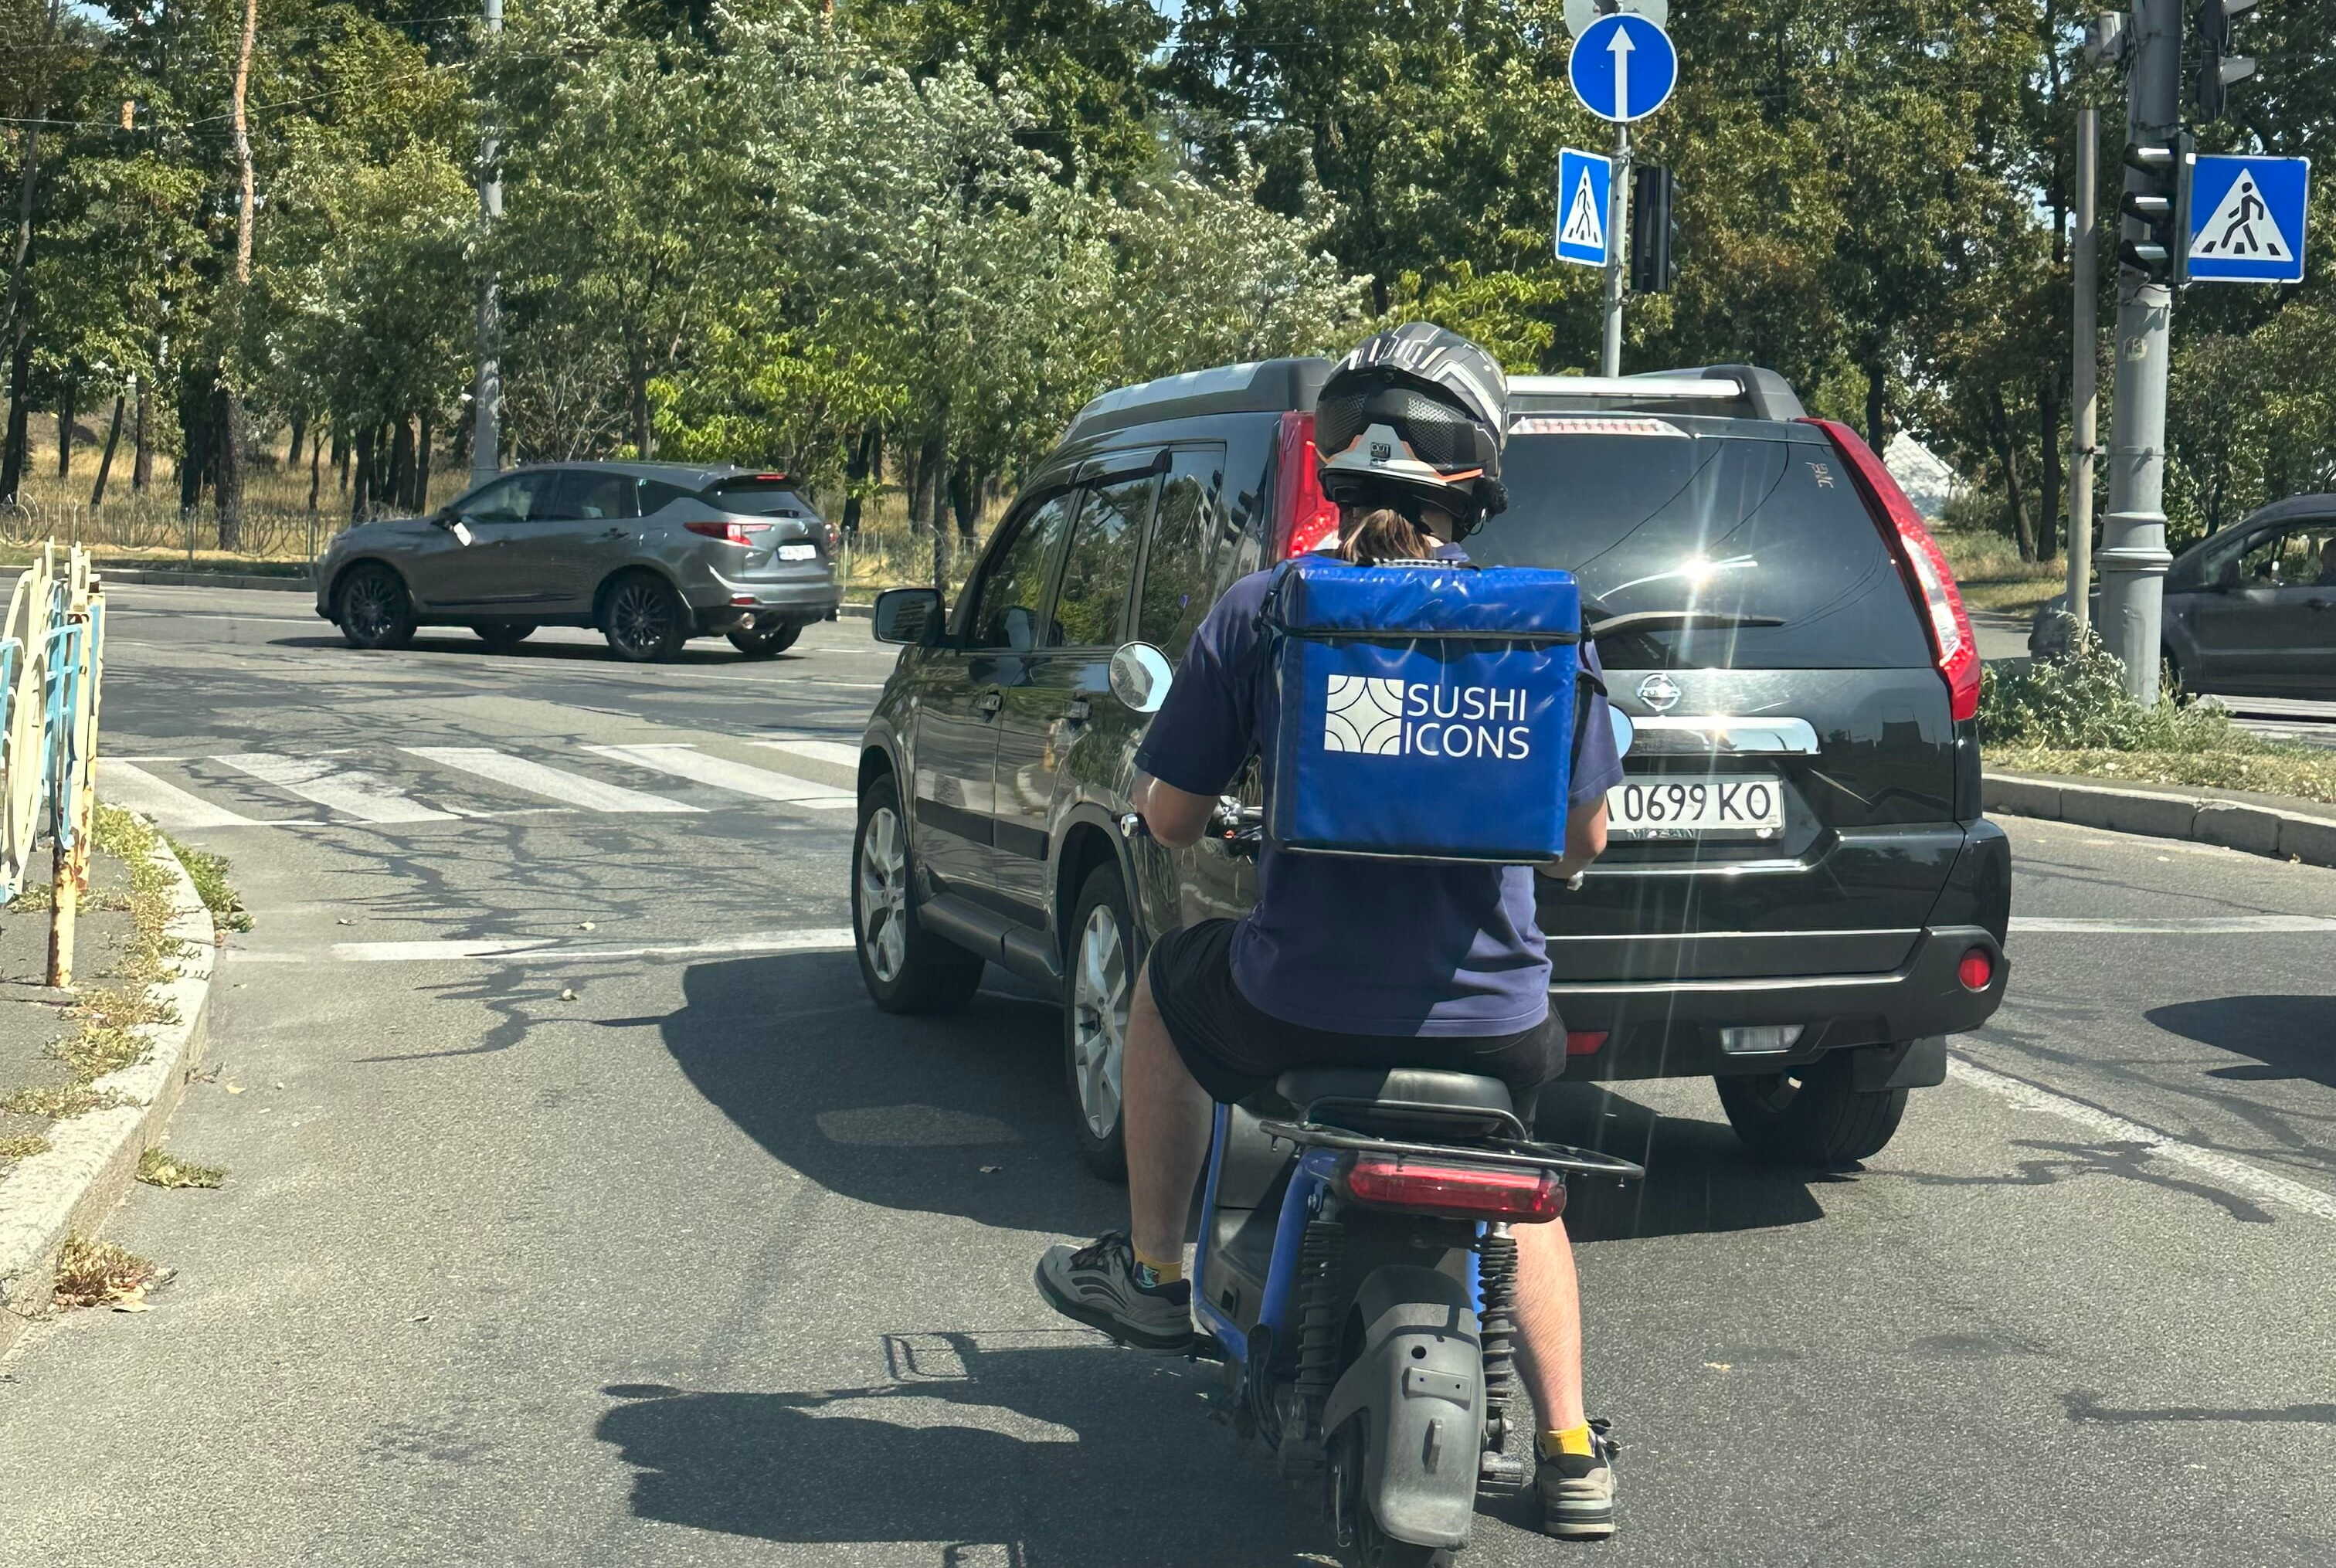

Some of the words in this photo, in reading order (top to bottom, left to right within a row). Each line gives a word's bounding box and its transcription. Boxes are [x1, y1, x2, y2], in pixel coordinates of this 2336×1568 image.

[1407, 684, 1526, 721] SUSHI
[1405, 722, 1530, 760] ICONS
[1624, 784, 1707, 821] 0699
[1719, 783, 1771, 821] KO
